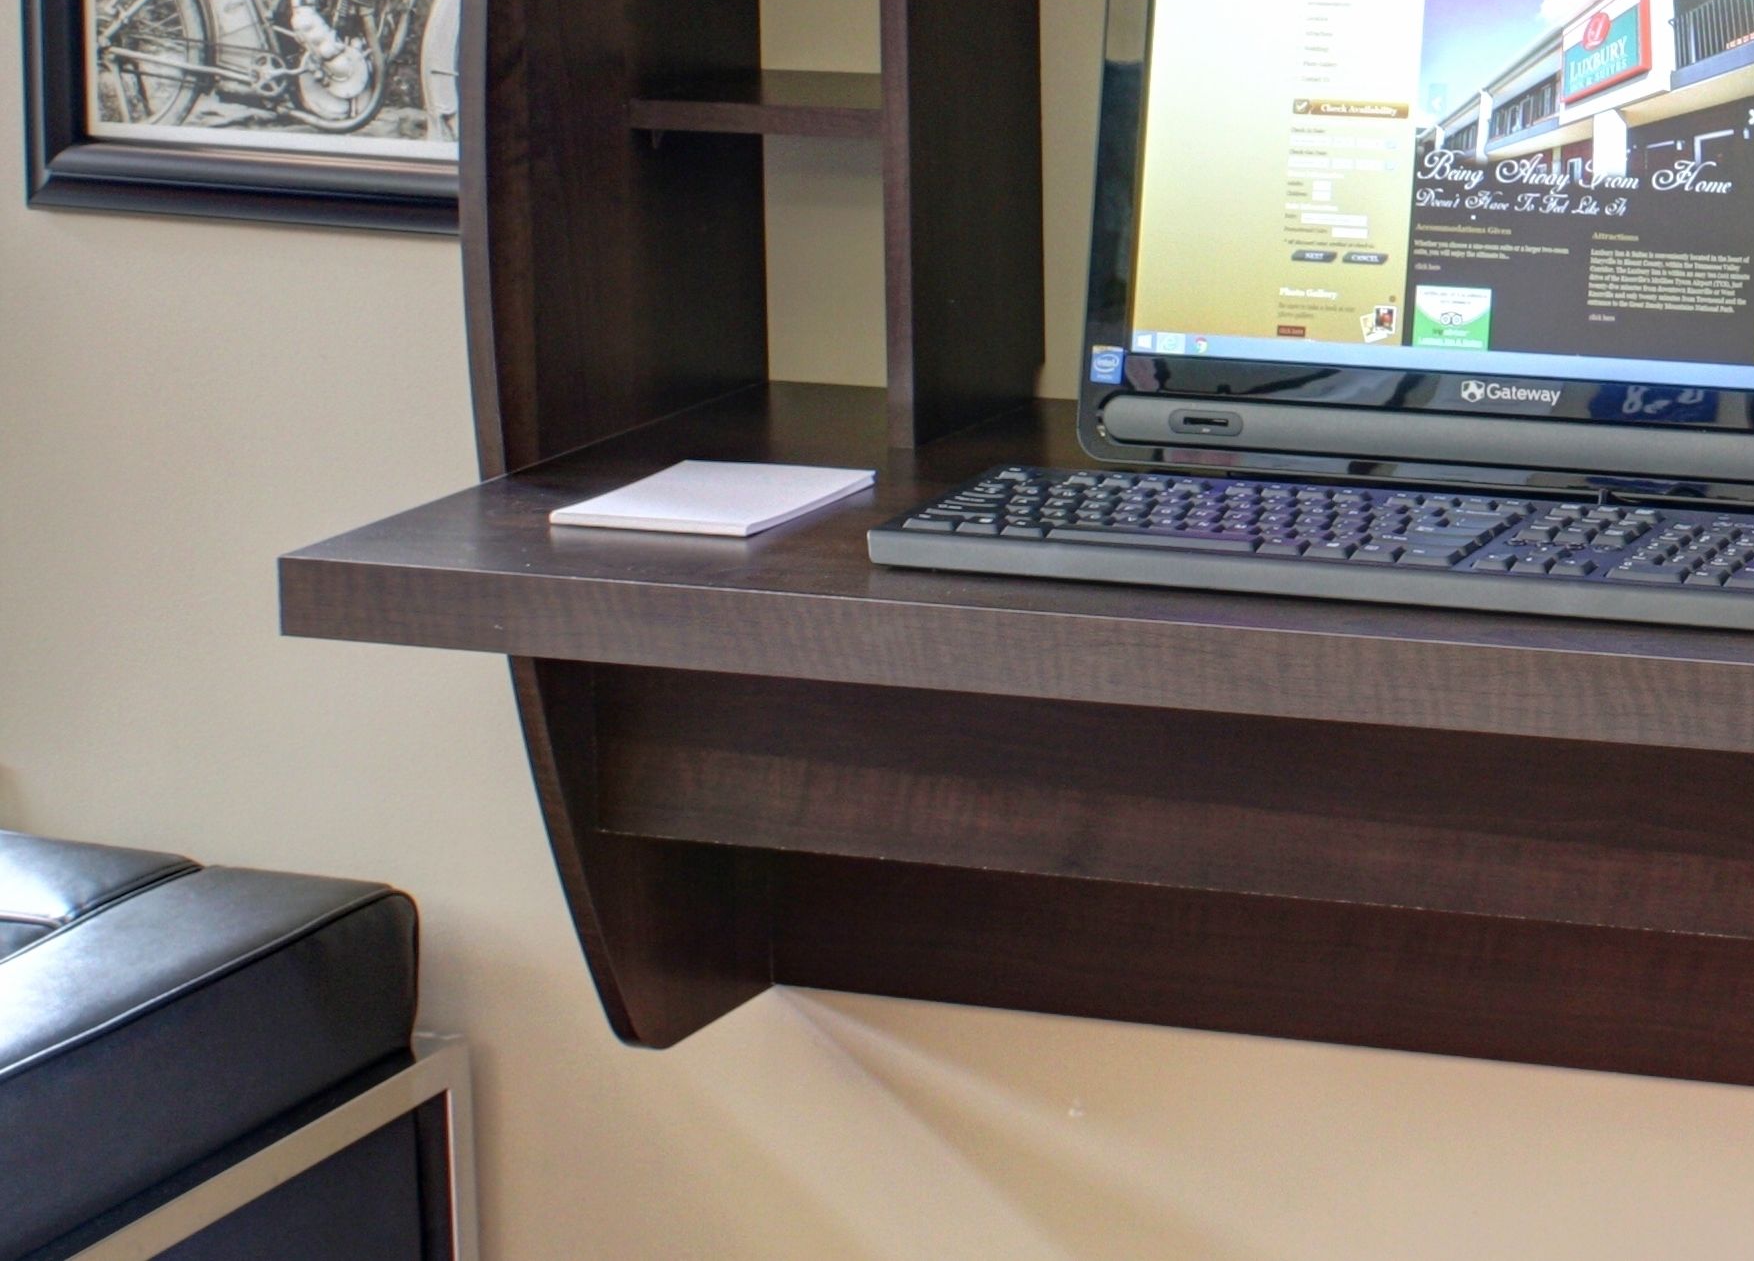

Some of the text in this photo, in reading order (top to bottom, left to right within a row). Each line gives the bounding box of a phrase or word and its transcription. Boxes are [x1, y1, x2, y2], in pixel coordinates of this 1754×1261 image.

[1570, 35, 1627, 81] LUXBURY
[1321, 104, 1398, 117] Check Availability
[1417, 149, 1484, 190] Being
[1495, 153, 1571, 194] Away
[1651, 159, 1733, 194] Home
[1416, 188, 1460, 209] Doesn't
[1465, 191, 1509, 211] Have
[1514, 193, 1541, 213] To
[1571, 195, 1600, 216] Like
[1416, 224, 1512, 235] Accommodations Given
[1592, 232, 1639, 241] Attractions
[1486, 383, 1561, 406] Gateway
